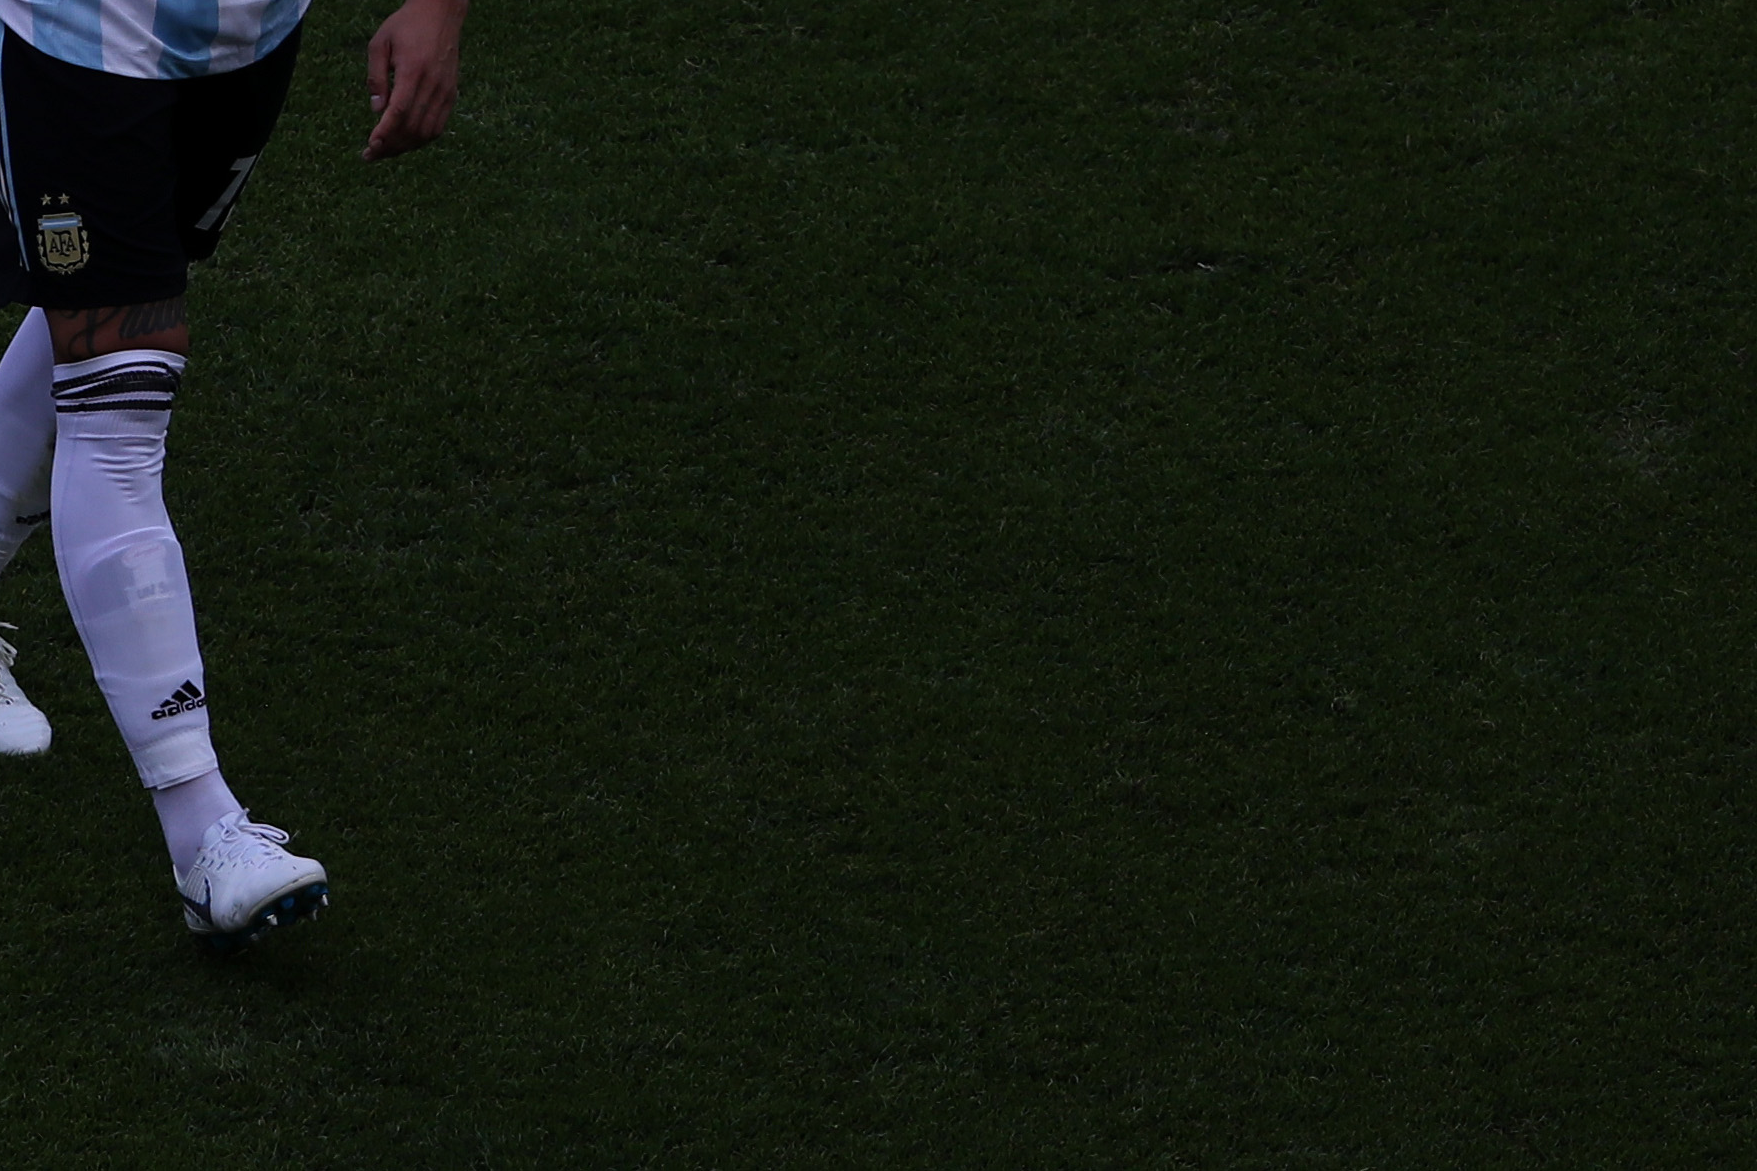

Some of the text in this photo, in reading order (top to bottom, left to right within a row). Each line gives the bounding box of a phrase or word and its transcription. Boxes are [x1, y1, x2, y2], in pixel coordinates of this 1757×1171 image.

[193, 153, 257, 231] 1
[49, 231, 78, 257] AFA
[150, 698, 207, 721] adida
